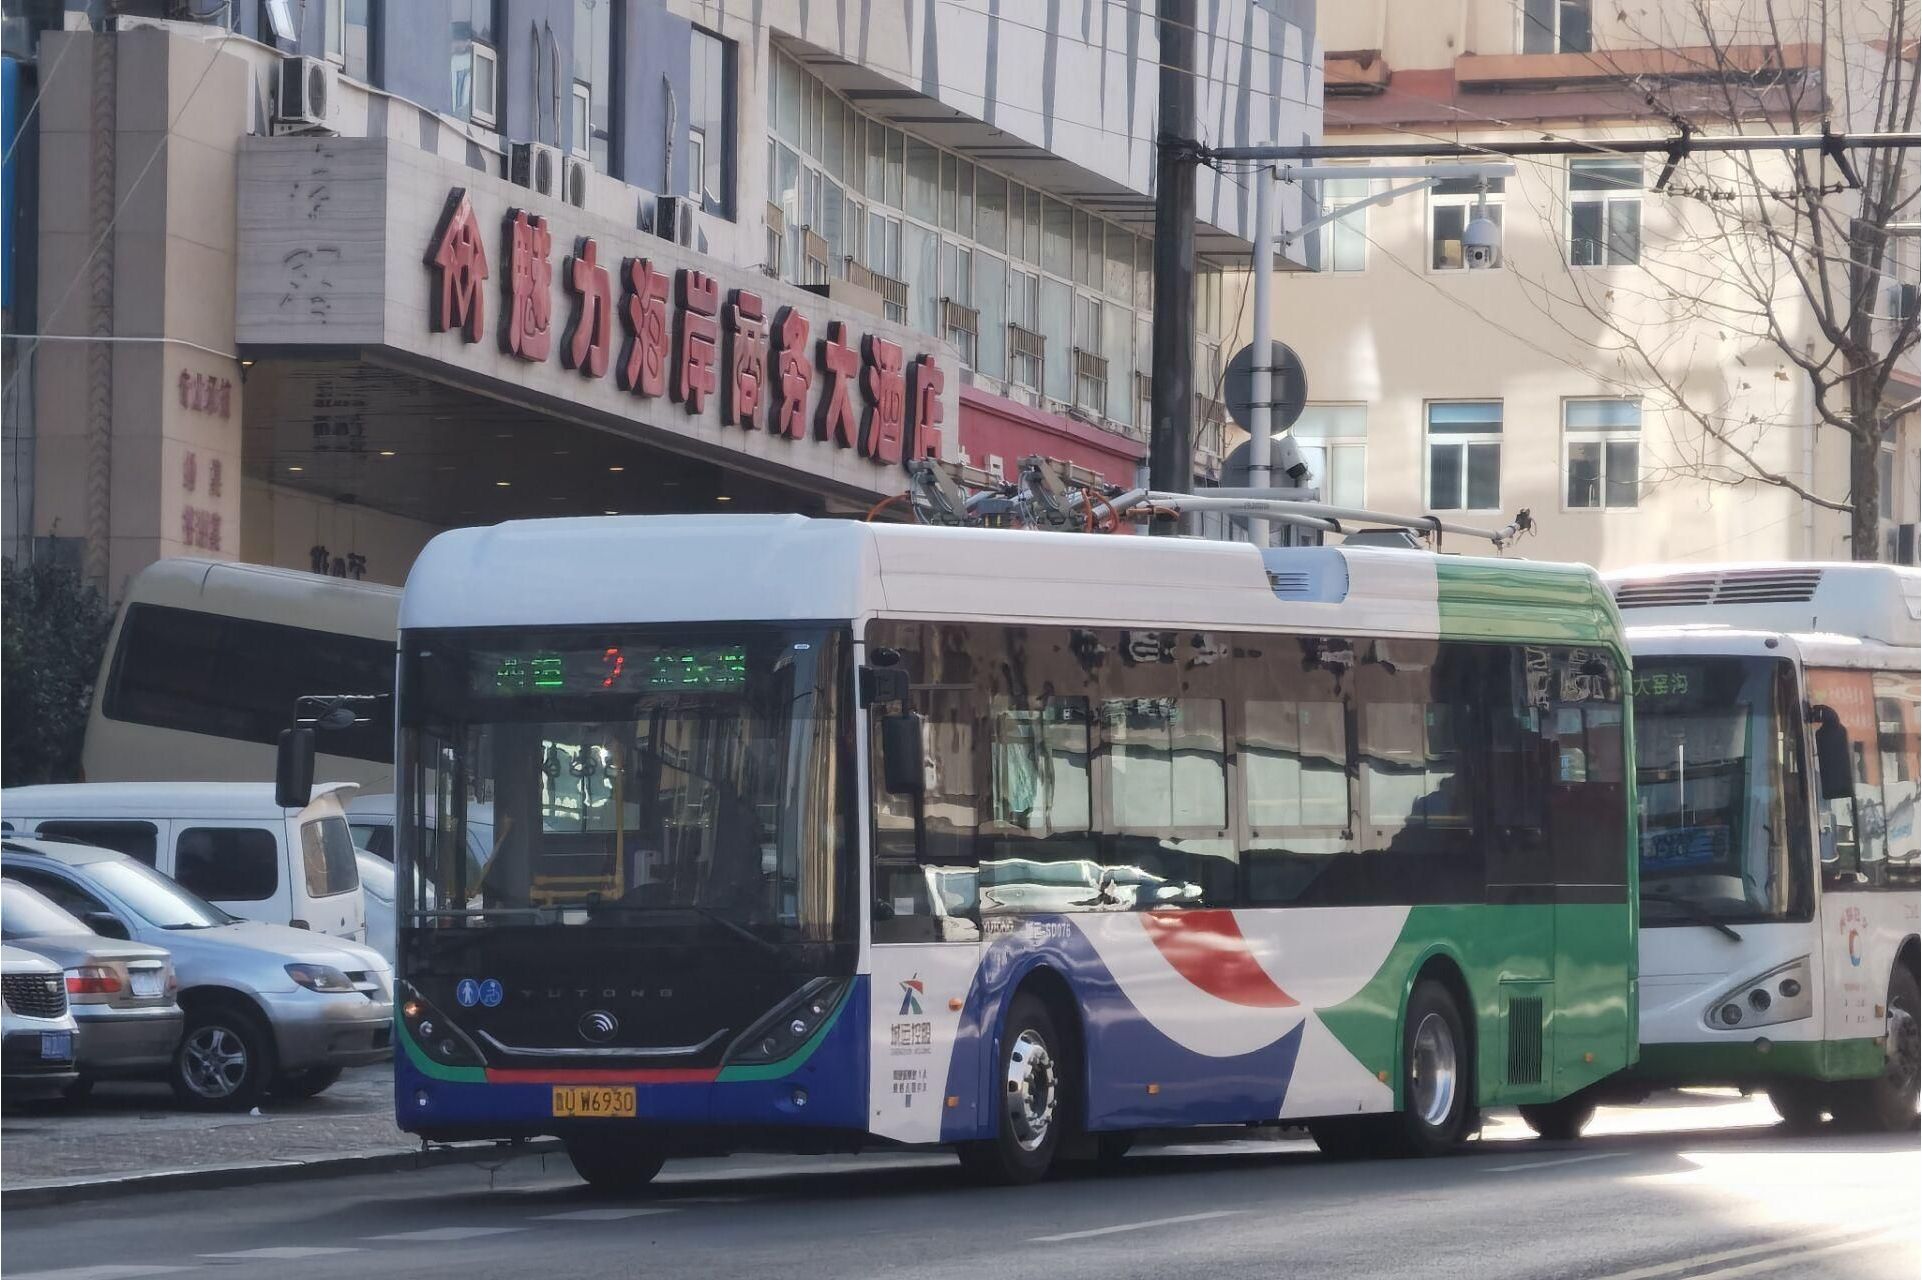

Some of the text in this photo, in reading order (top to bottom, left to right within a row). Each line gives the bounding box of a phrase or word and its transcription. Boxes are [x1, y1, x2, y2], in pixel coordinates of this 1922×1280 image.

[502, 207, 945, 466] 魅力海岸商务大酒店
